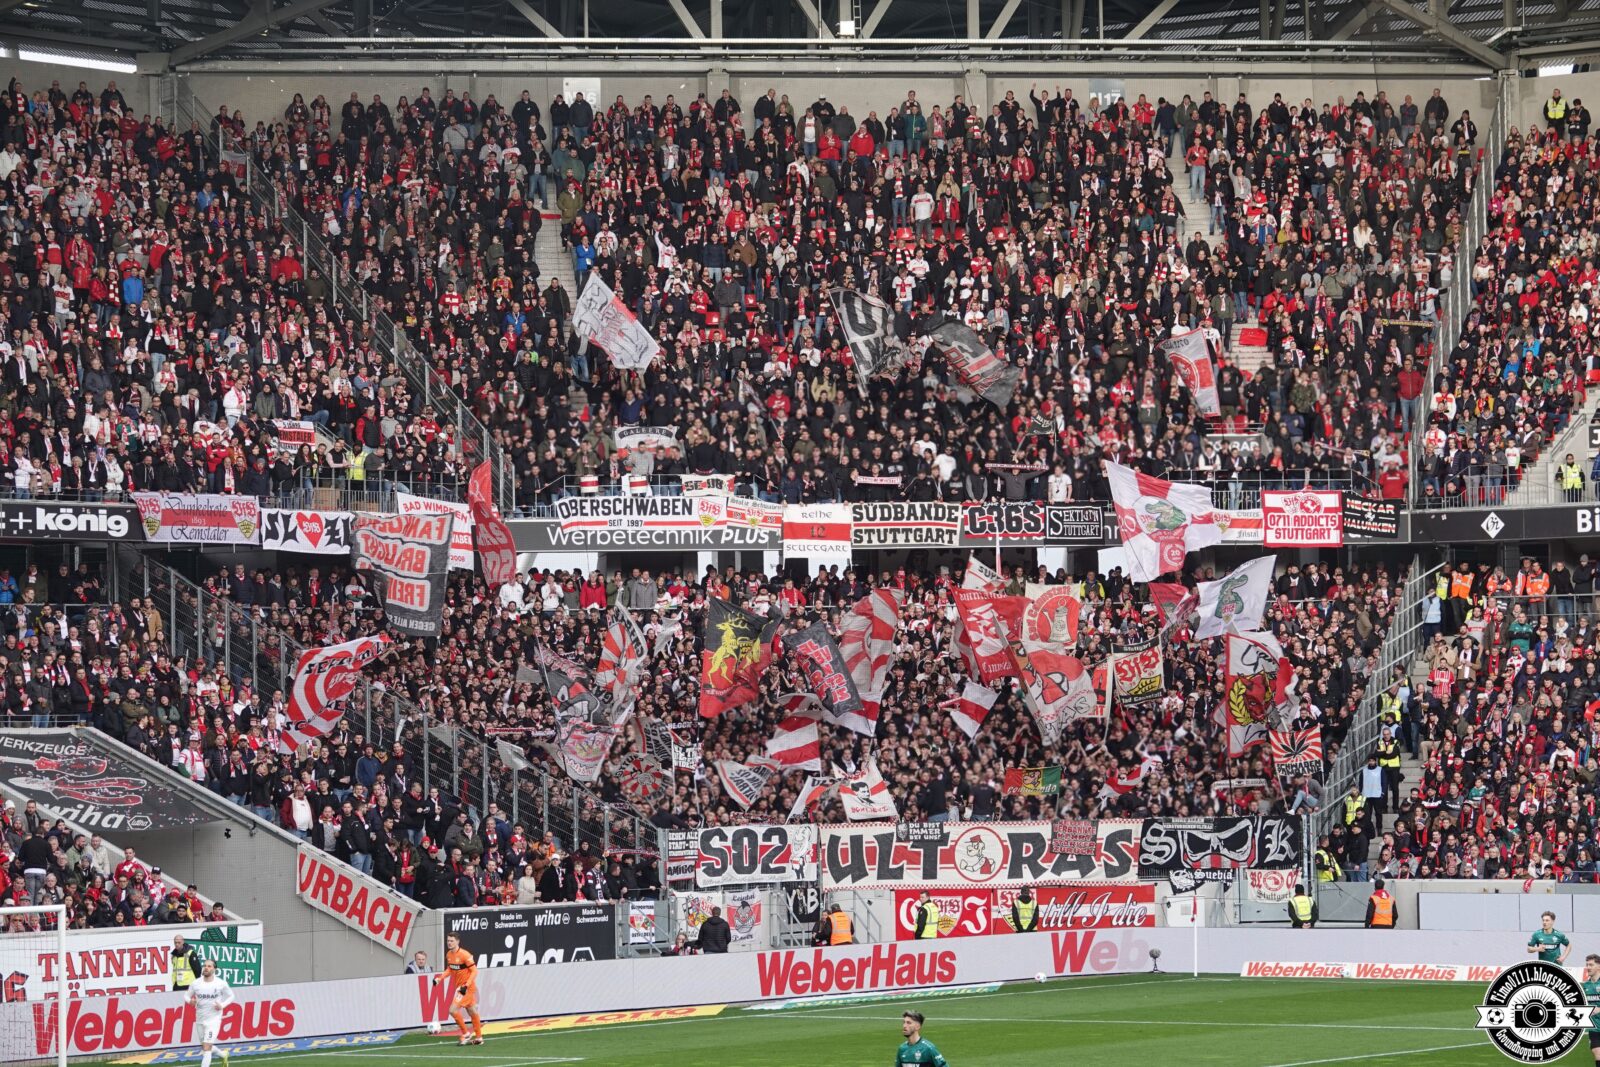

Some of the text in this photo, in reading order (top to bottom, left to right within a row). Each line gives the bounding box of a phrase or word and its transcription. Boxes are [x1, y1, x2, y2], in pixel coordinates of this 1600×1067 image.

[558, 499, 693, 519] OBERSCHWABEN
[852, 503, 959, 522] SÜDBANDE
[1347, 498, 1395, 514] NECKAR
[36, 507, 129, 537] könig
[608, 519, 623, 527] SEIT
[968, 505, 1042, 535] C36S
[1269, 515, 1337, 527] 0711 ADDICTS
[1344, 518, 1396, 533] HALUNKEN
[721, 529, 770, 544] PLUS
[854, 528, 957, 544] STUTTGART
[1275, 529, 1331, 540] STUTTGART
[43, 803, 126, 829] wiha
[299, 852, 412, 948] URBACH
[1042, 892, 1079, 927] till
[1111, 893, 1148, 926] die
[452, 915, 479, 931] wiha
[494, 921, 528, 929] Schwarzwald
[535, 910, 561, 926] wiha
[576, 915, 609, 923] Schwarzwald
[38, 946, 170, 982] TANNEN
[757, 944, 956, 996] WeberHaus
[1248, 962, 1344, 978] WeberHaus
[1355, 963, 1456, 980] WeberHaus
[573, 1007, 698, 1024] LOTTO
[163, 1032, 395, 1060] EUOPA PARK
